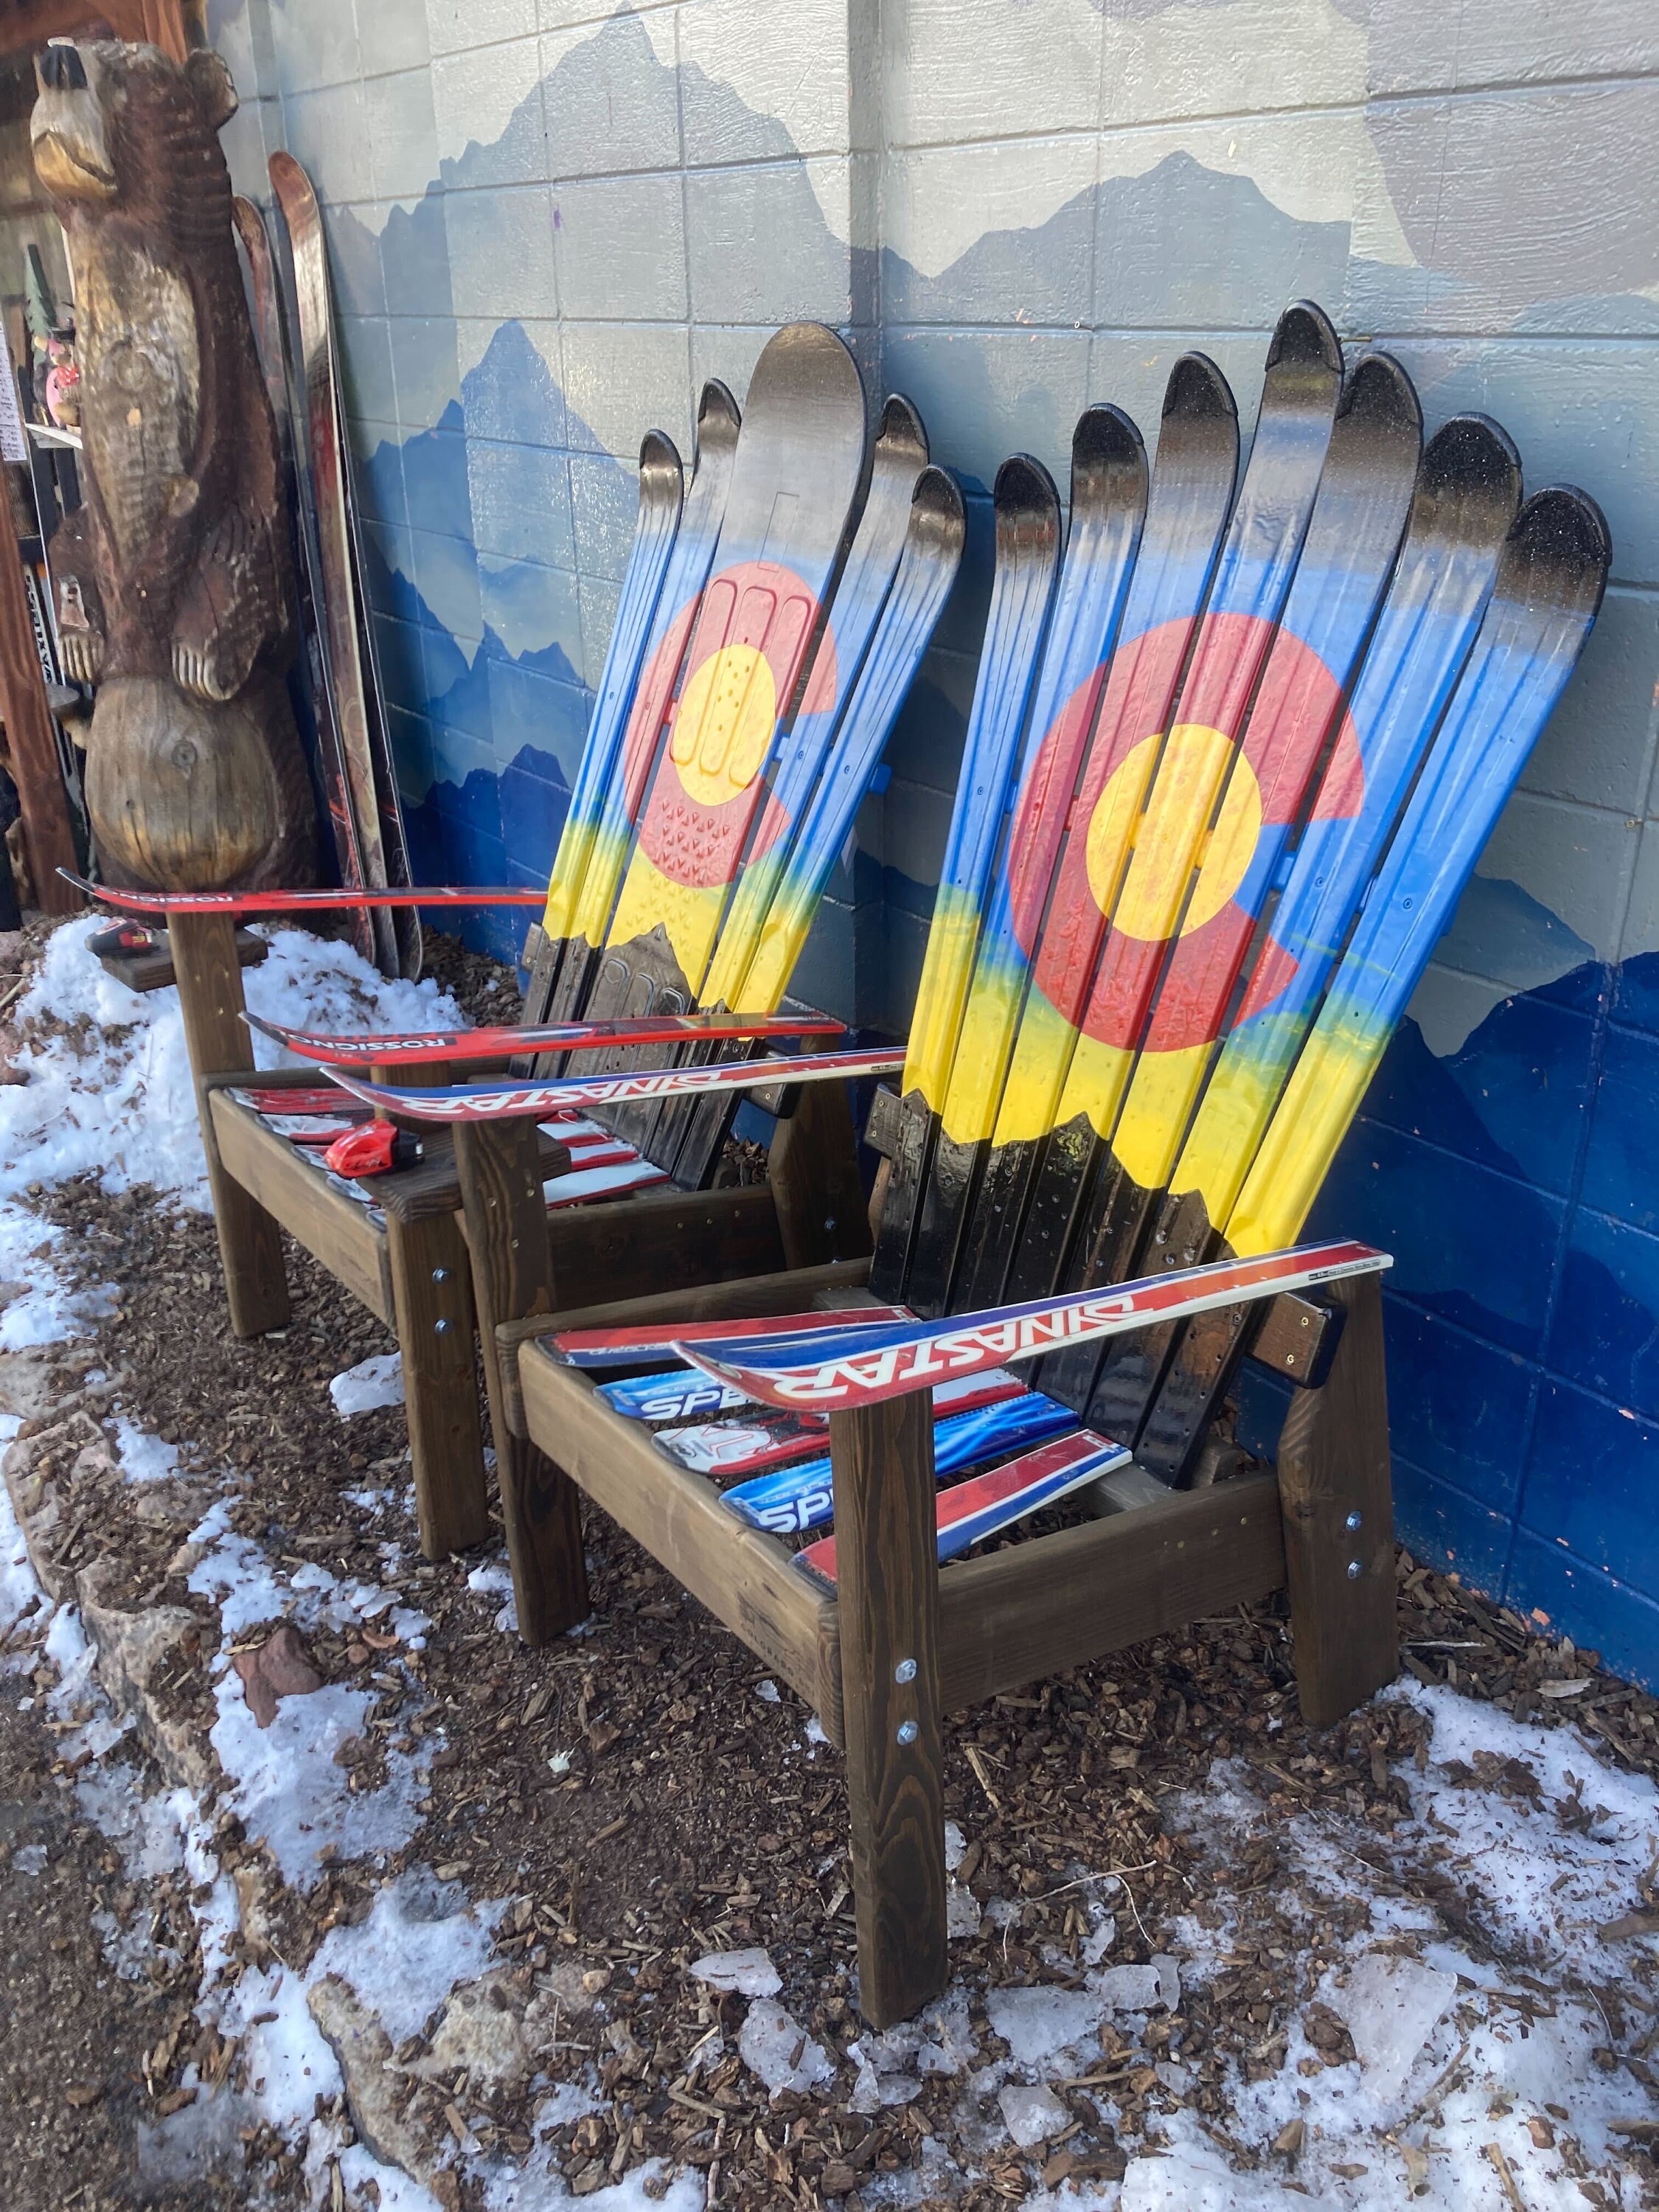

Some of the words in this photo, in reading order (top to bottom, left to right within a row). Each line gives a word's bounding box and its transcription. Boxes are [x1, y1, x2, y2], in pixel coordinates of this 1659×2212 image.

[402, 1071, 734, 1114] DYNASTAR
[773, 1295, 1154, 1399] DYNASTAR
[641, 1388, 752, 1420] SPE
[758, 1488, 834, 1533] SP
